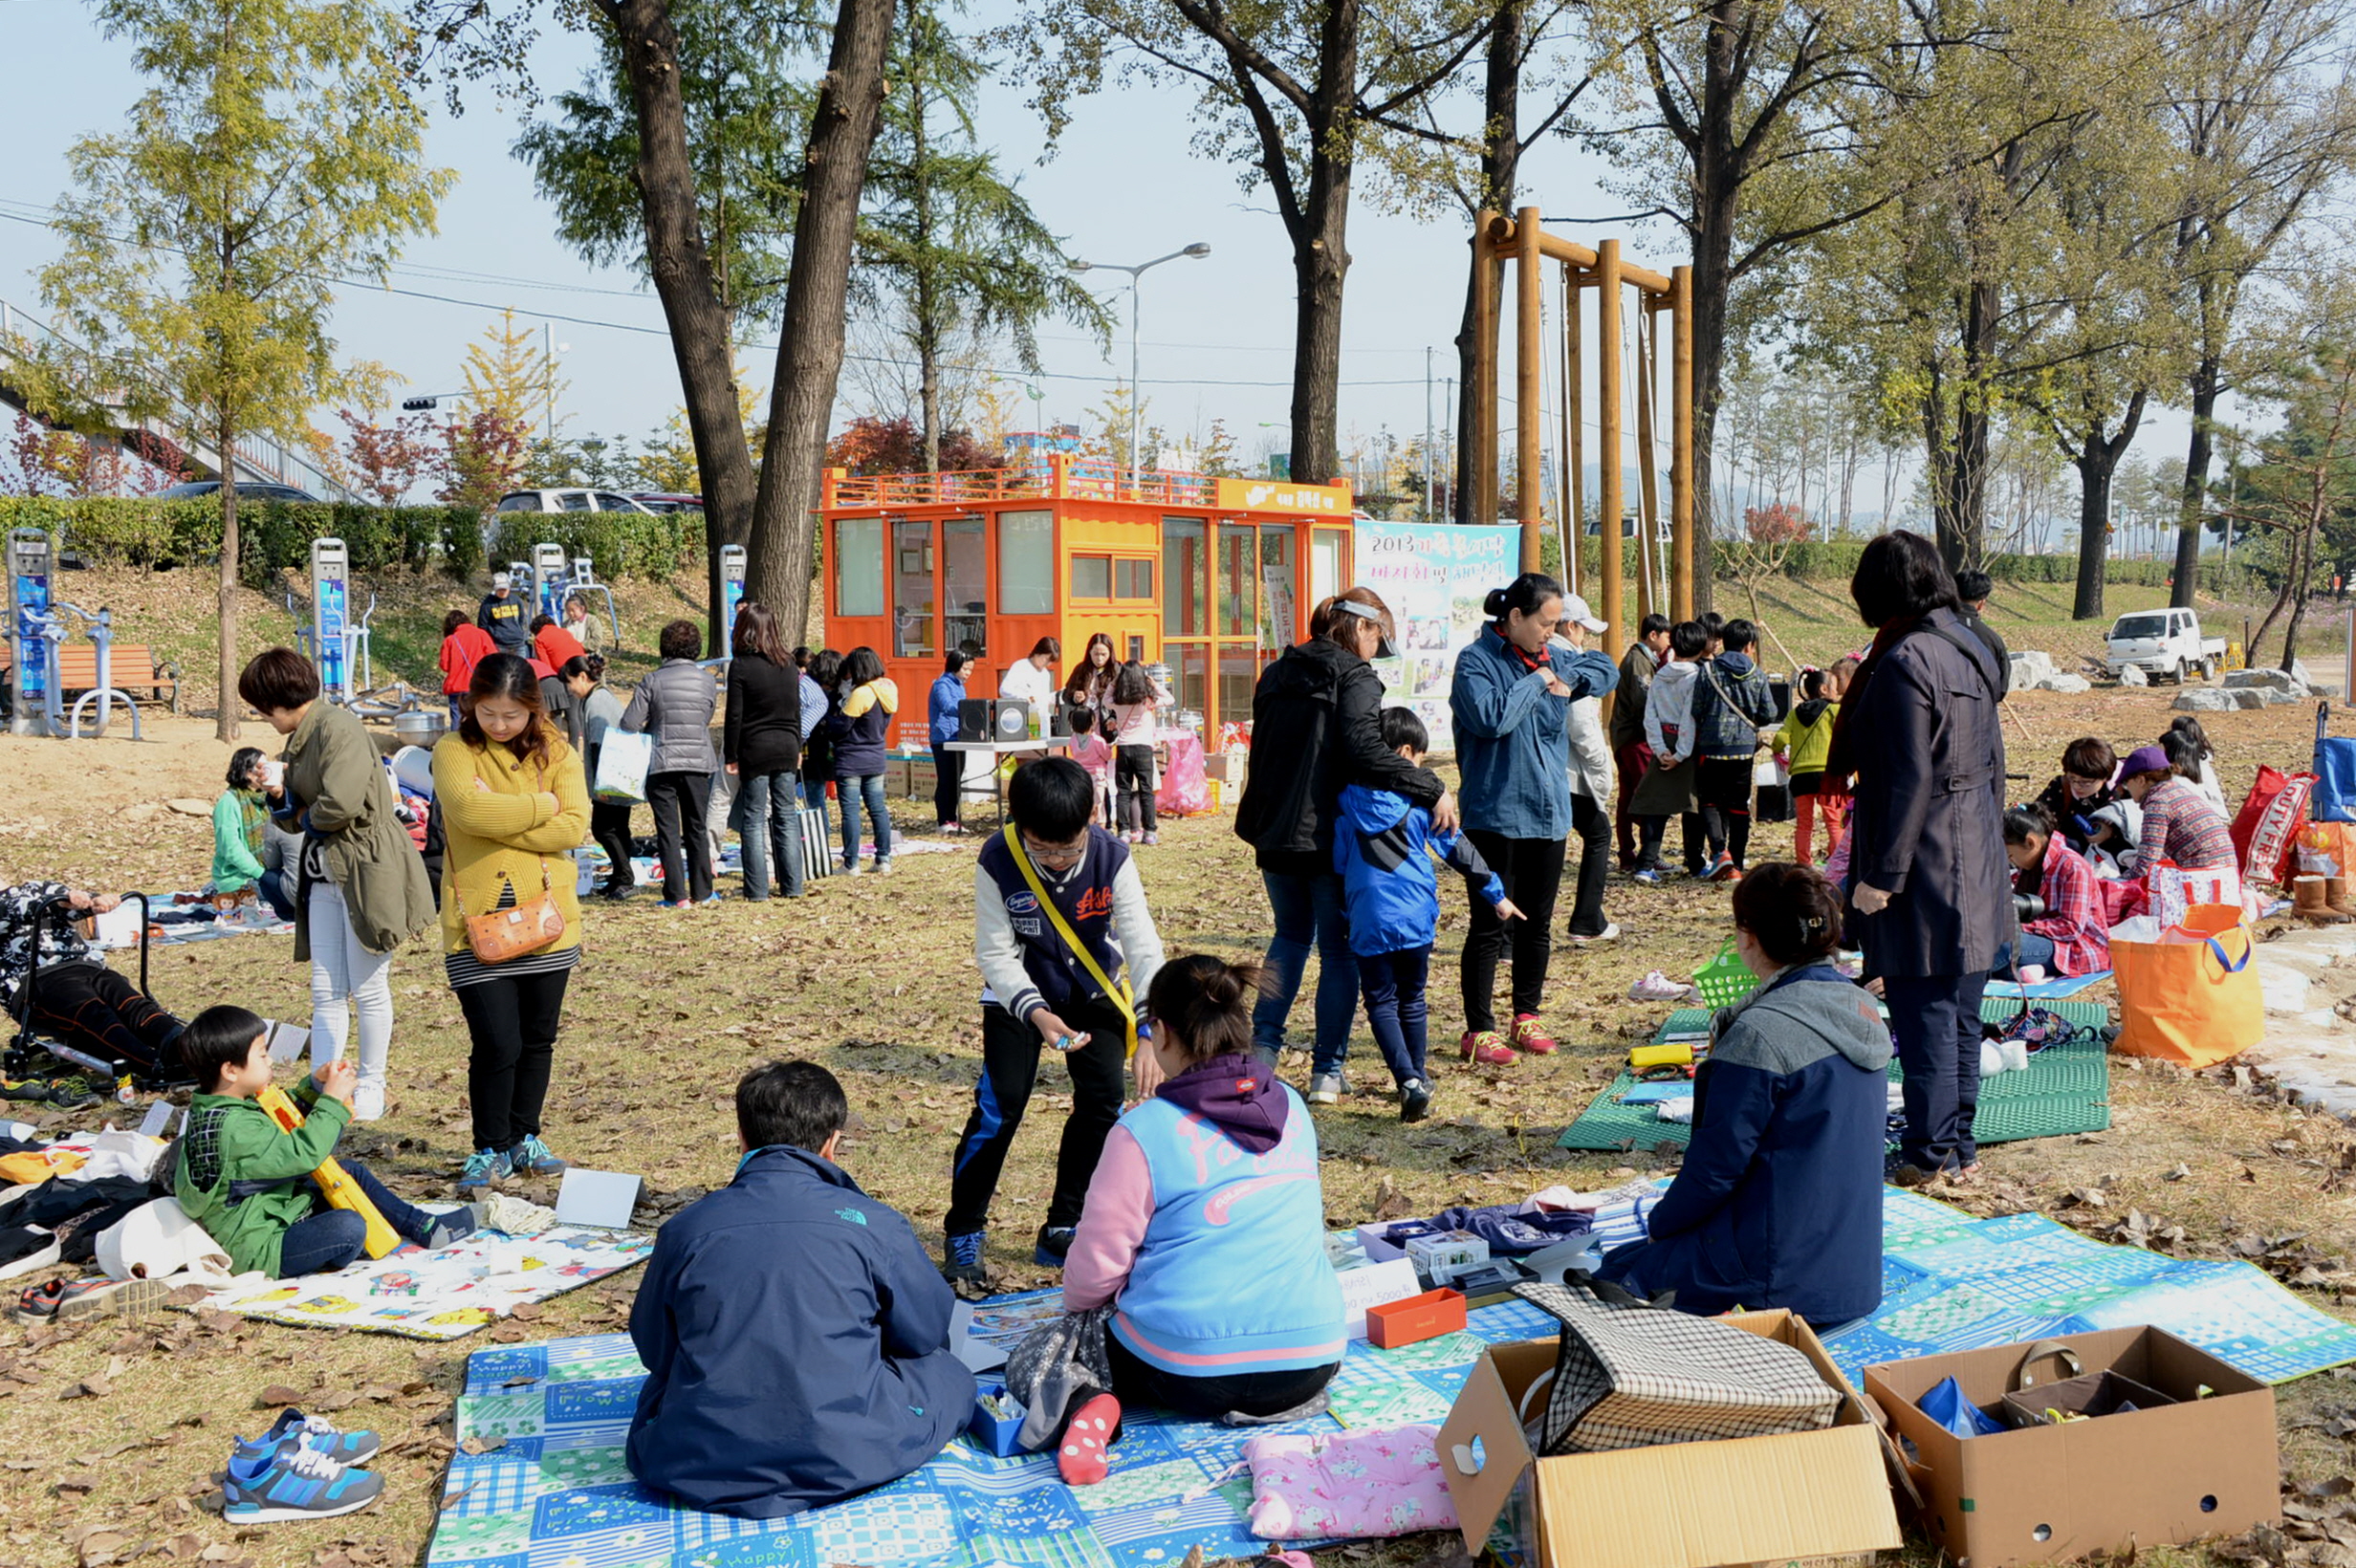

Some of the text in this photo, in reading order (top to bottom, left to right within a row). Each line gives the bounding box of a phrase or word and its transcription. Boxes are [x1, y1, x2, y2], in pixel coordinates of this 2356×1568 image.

[1370, 562, 1429, 580] 바자회
[2254, 786, 2298, 874] DUTY FREE
[559, 1391, 641, 1406] Flower
[727, 1547, 796, 1567] Happy!
